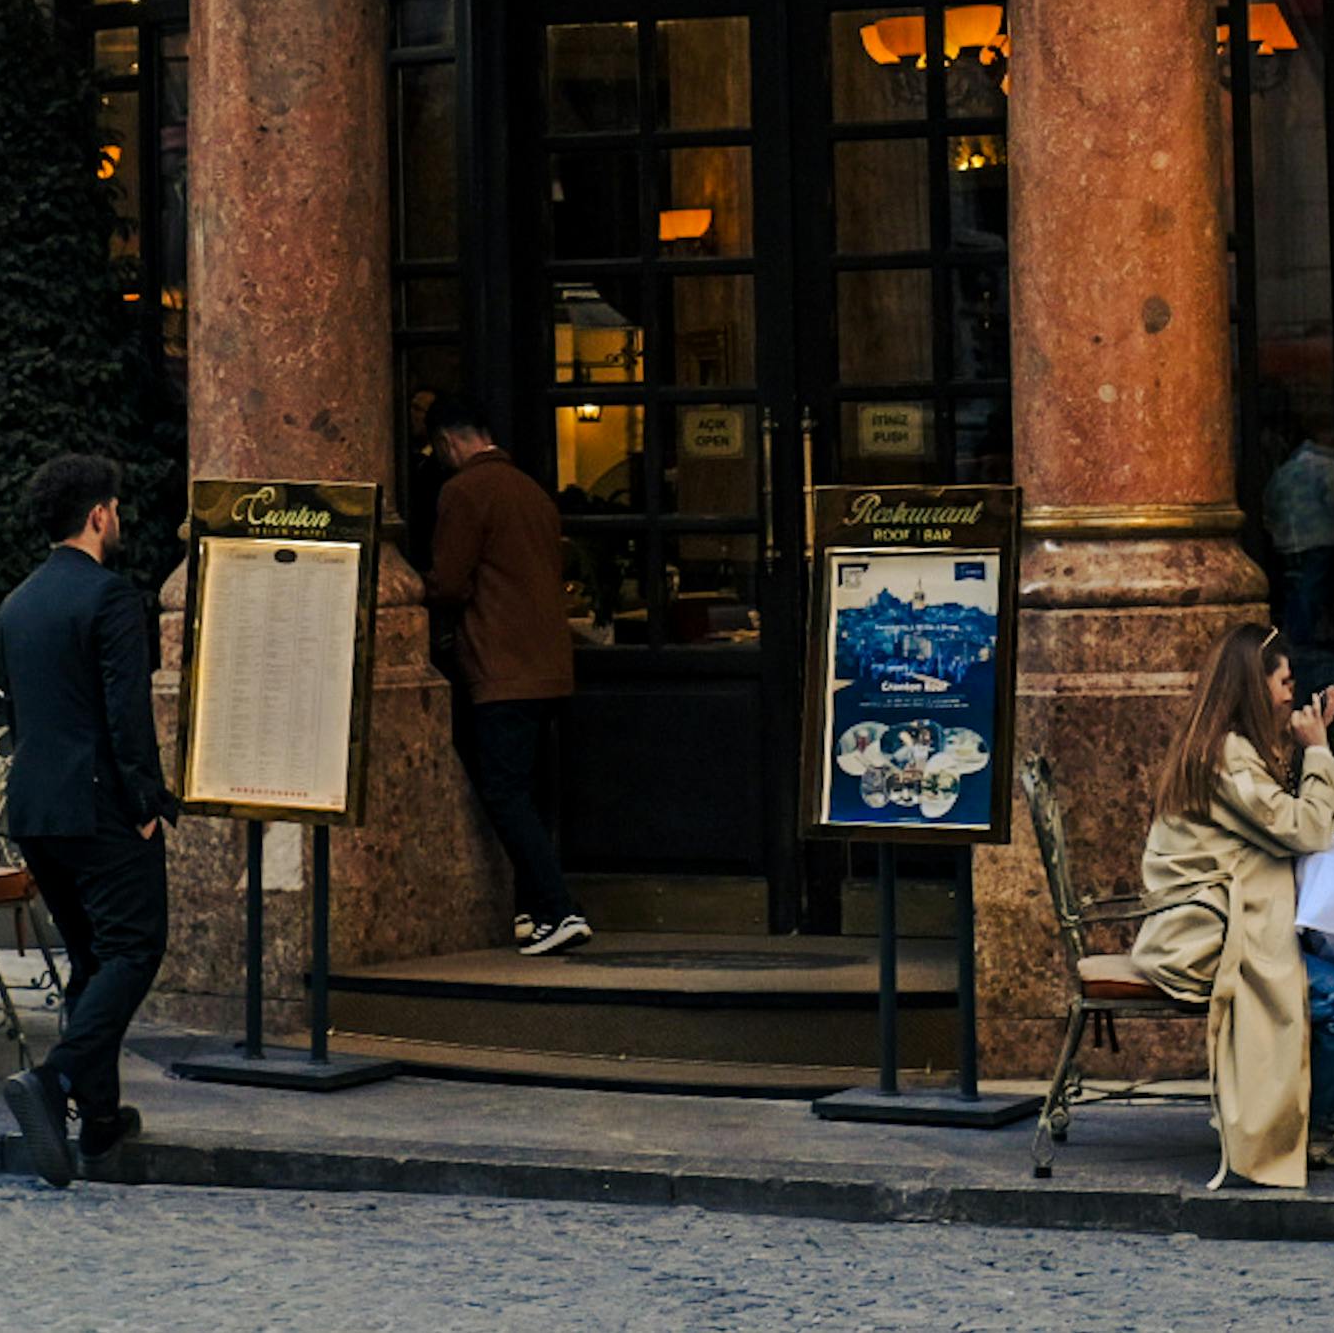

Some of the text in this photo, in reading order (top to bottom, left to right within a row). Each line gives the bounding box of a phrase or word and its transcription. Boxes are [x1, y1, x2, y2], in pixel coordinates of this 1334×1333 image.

[695, 435, 730, 448] OPEN
[873, 430, 908, 444] PUSH
[843, 493, 984, 527] Restaurant
[873, 528, 952, 542] ROOF BAR
